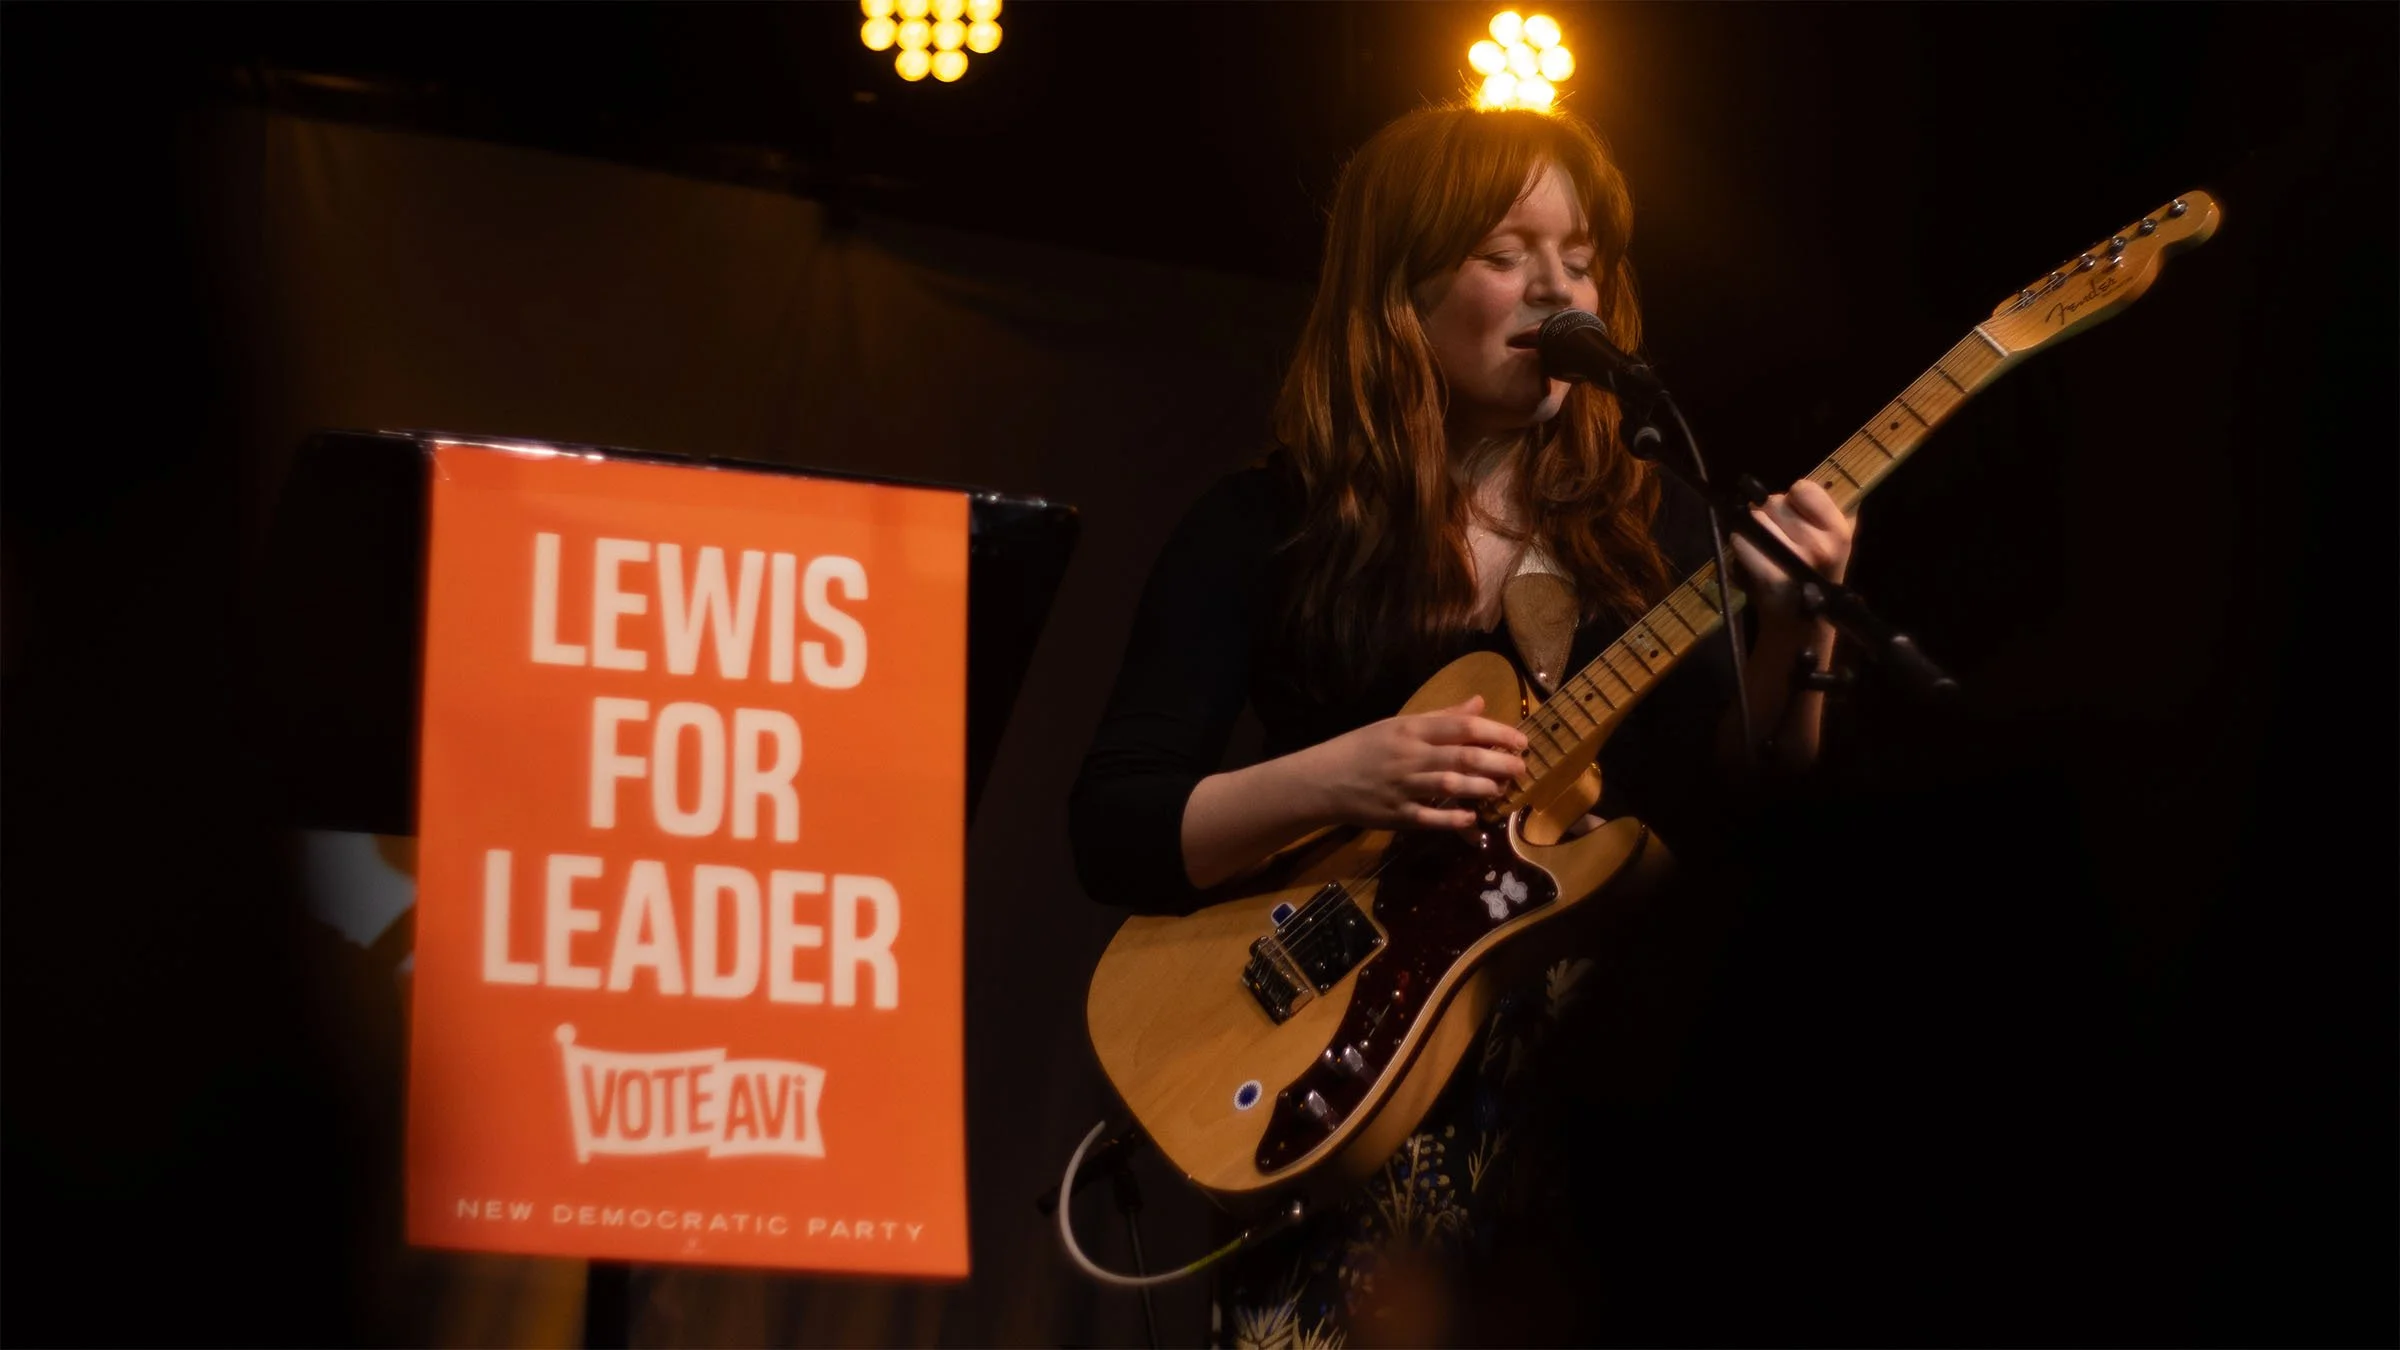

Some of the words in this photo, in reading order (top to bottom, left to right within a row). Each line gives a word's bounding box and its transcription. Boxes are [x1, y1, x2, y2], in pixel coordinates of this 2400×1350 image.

[2044, 277, 2117, 326] Fender
[531, 532, 869, 689] LEWIS
[590, 696, 801, 842] FOR
[482, 849, 900, 1010] LEADER
[580, 1064, 714, 1141] VOTE
[456, 1198, 534, 1221] NEW
[552, 1204, 788, 1235] DEMOCRATIC
[807, 1216, 924, 1242] PARTY
